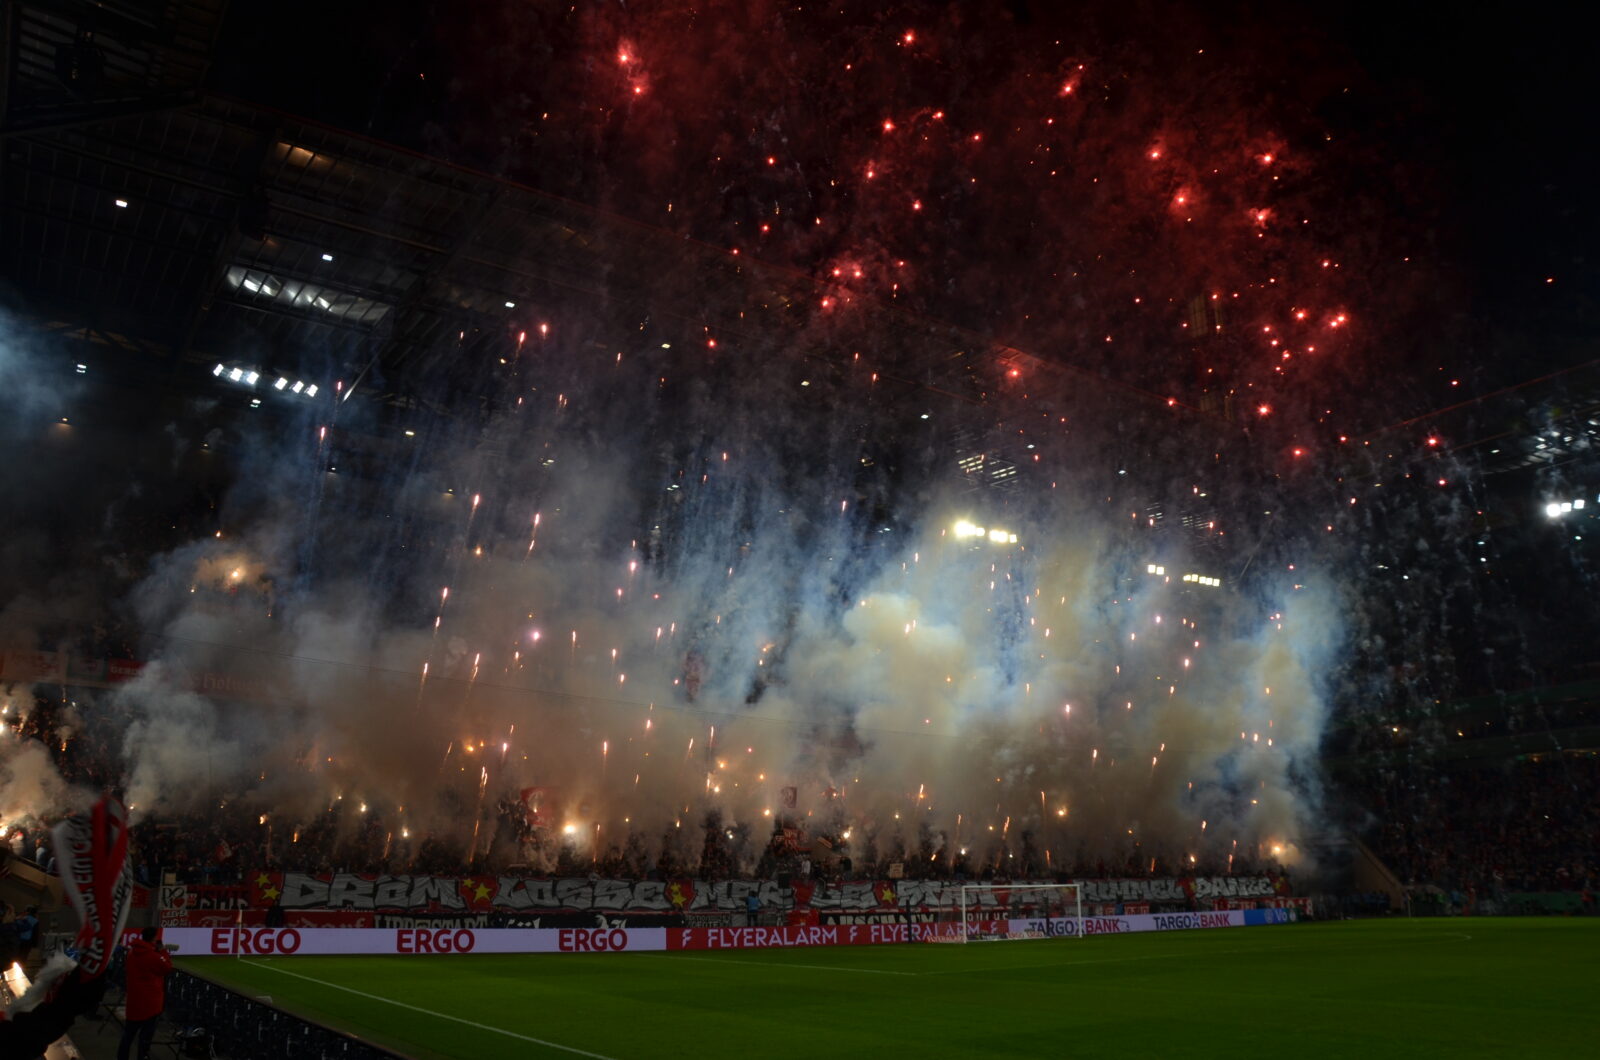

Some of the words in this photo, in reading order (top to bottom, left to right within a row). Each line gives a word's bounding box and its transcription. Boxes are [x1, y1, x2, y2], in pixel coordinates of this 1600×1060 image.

[492, 877, 673, 910] LOSSE
[1195, 877, 1274, 898] DANZE
[211, 929, 301, 954] ERGO
[396, 929, 475, 953] ERGO
[558, 929, 628, 952] ERGO
[707, 927, 838, 948] FLYERALARM
